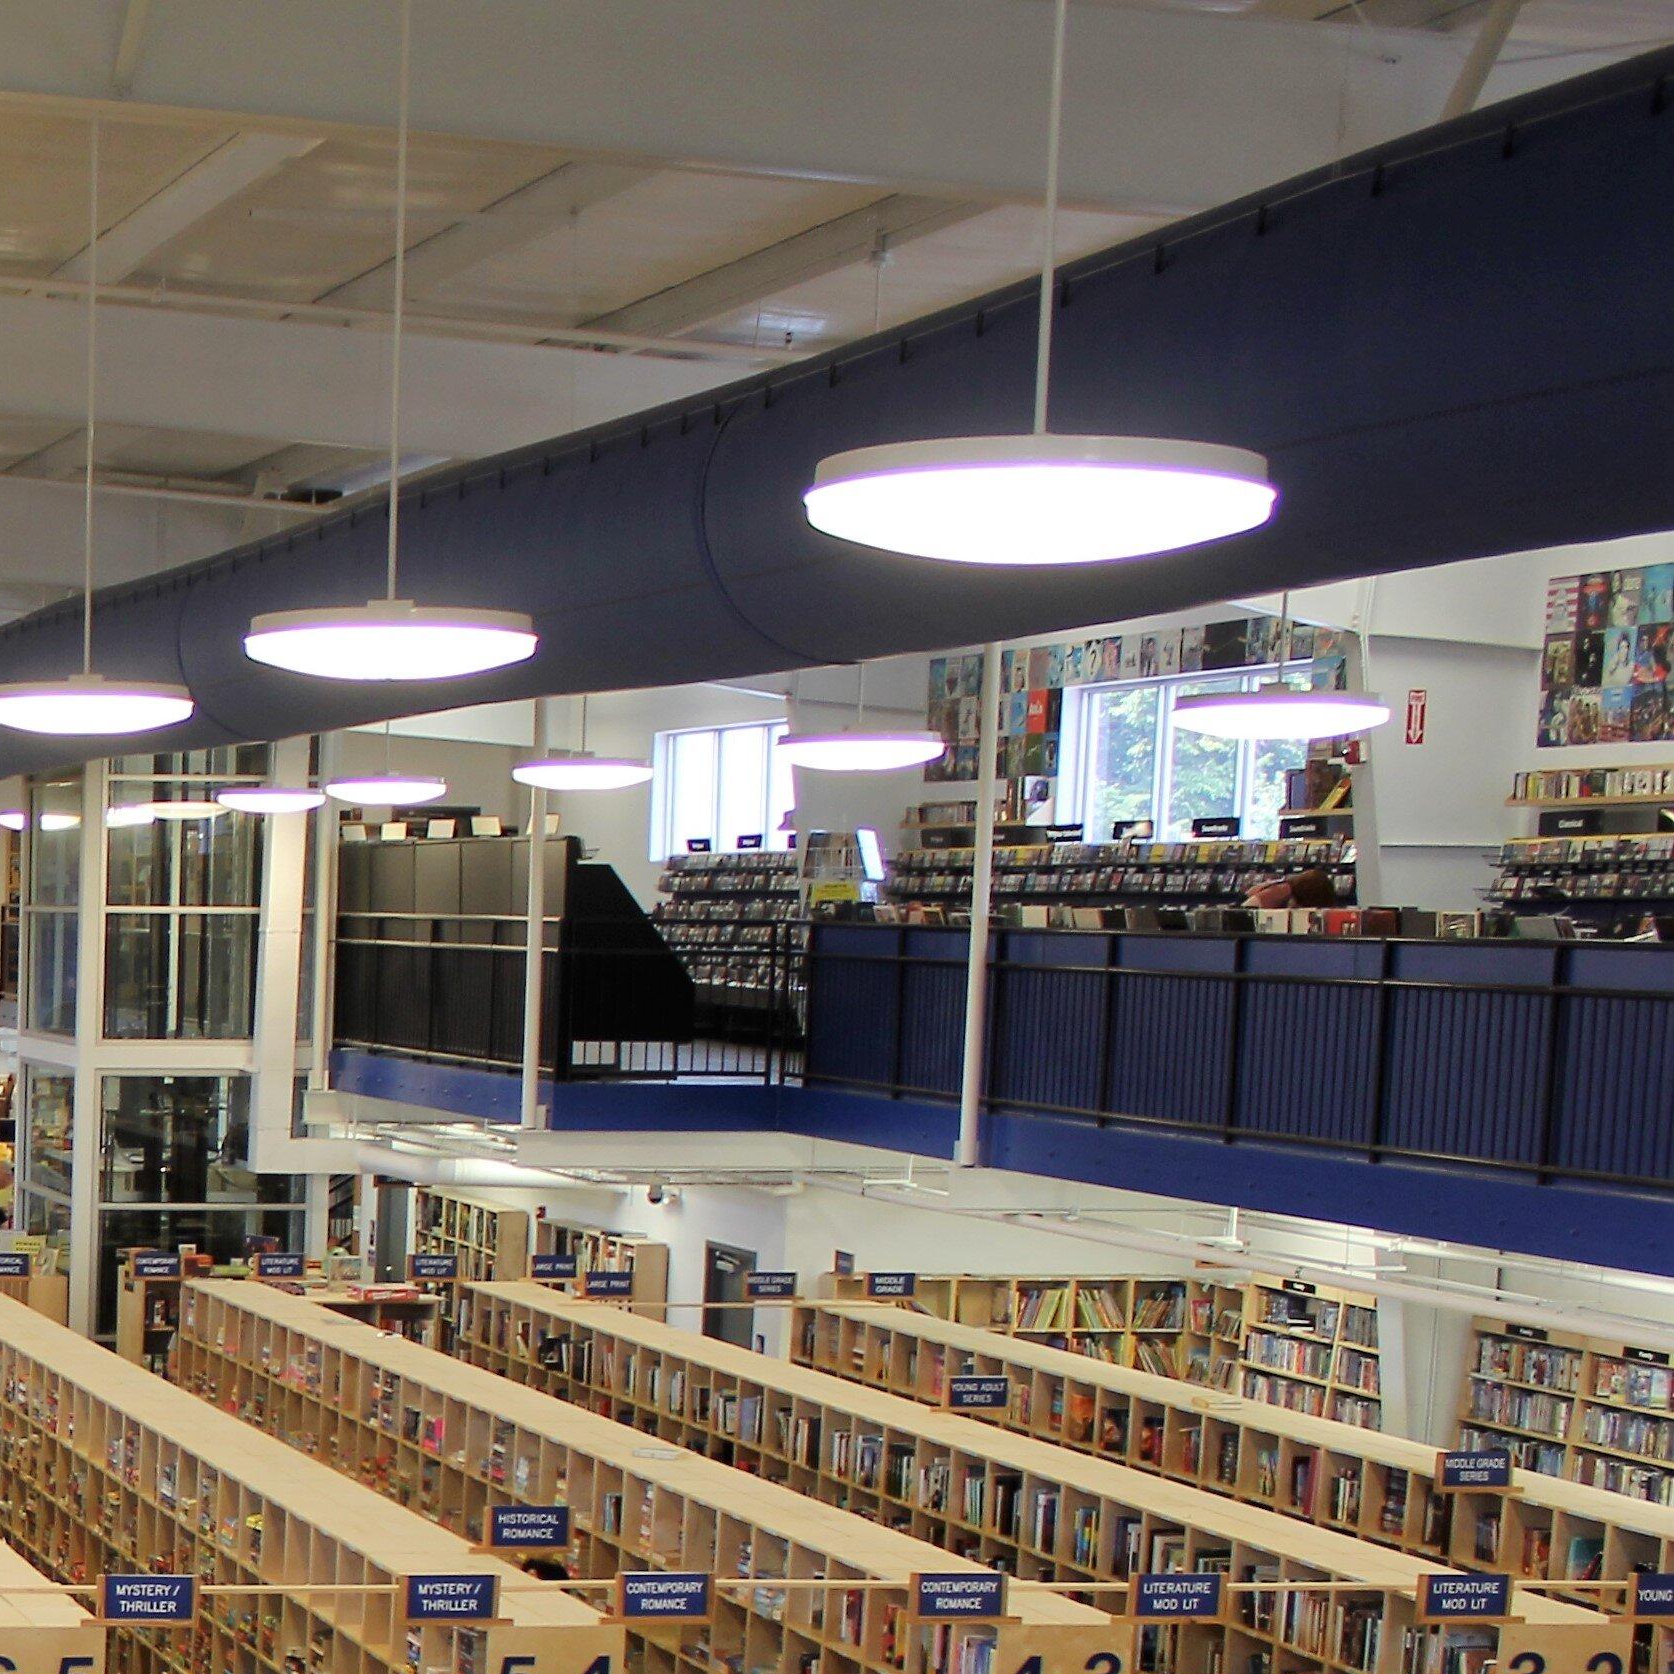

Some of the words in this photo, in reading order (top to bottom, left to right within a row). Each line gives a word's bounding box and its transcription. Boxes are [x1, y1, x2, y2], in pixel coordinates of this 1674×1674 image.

[497, 1513, 559, 1525] HISTORICAL
[502, 1527, 554, 1539] ROMANCE
[115, 1583, 181, 1597] MYSTERY/
[418, 1582, 482, 1596] MYSTERY/
[625, 1581, 704, 1595] CONTEMPORARY
[921, 1581, 998, 1594] CONTEMPORARY
[1143, 1581, 1212, 1595] LITERATURE
[1433, 1582, 1500, 1595] LITERATURE
[1637, 1589, 1674, 1602] YOUNG
[119, 1600, 177, 1613] THRILLER
[421, 1598, 478, 1612] THRILLER
[640, 1597, 688, 1610] ROMANCE
[935, 1597, 982, 1610] ROMANCE
[1152, 1598, 1179, 1611] MOD
[1182, 1597, 1200, 1611] LIT
[1441, 1597, 1467, 1610] MOD
[1470, 1597, 1488, 1610] LIT
